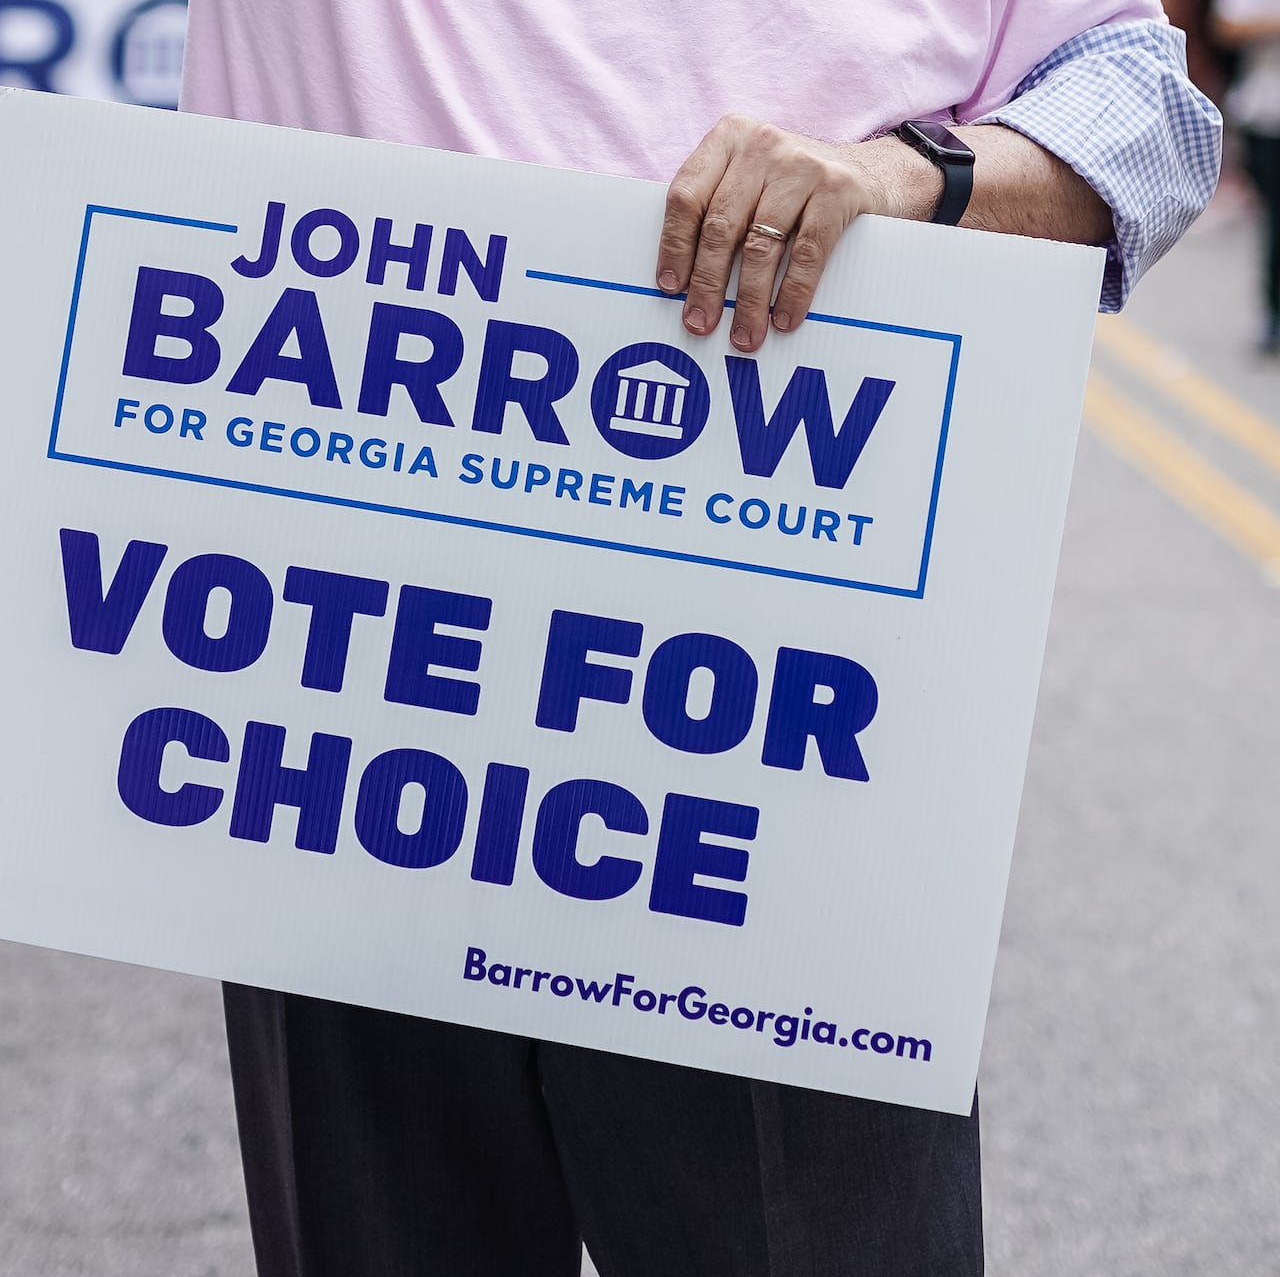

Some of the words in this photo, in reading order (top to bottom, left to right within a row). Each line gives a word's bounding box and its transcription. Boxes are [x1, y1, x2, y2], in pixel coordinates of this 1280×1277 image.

[229, 201, 509, 304] JOHN
[120, 265, 898, 491] BARROW
[113, 398, 208, 441] FOR
[225, 416, 439, 479] GEORGIA
[457, 453, 687, 517] SUPREME
[704, 492, 875, 547] COURT
[59, 527, 494, 718] VOTE
[534, 609, 880, 784] FOR
[117, 707, 761, 928] CHOICE
[462, 946, 933, 1063] BarrowForGeorgia.com
